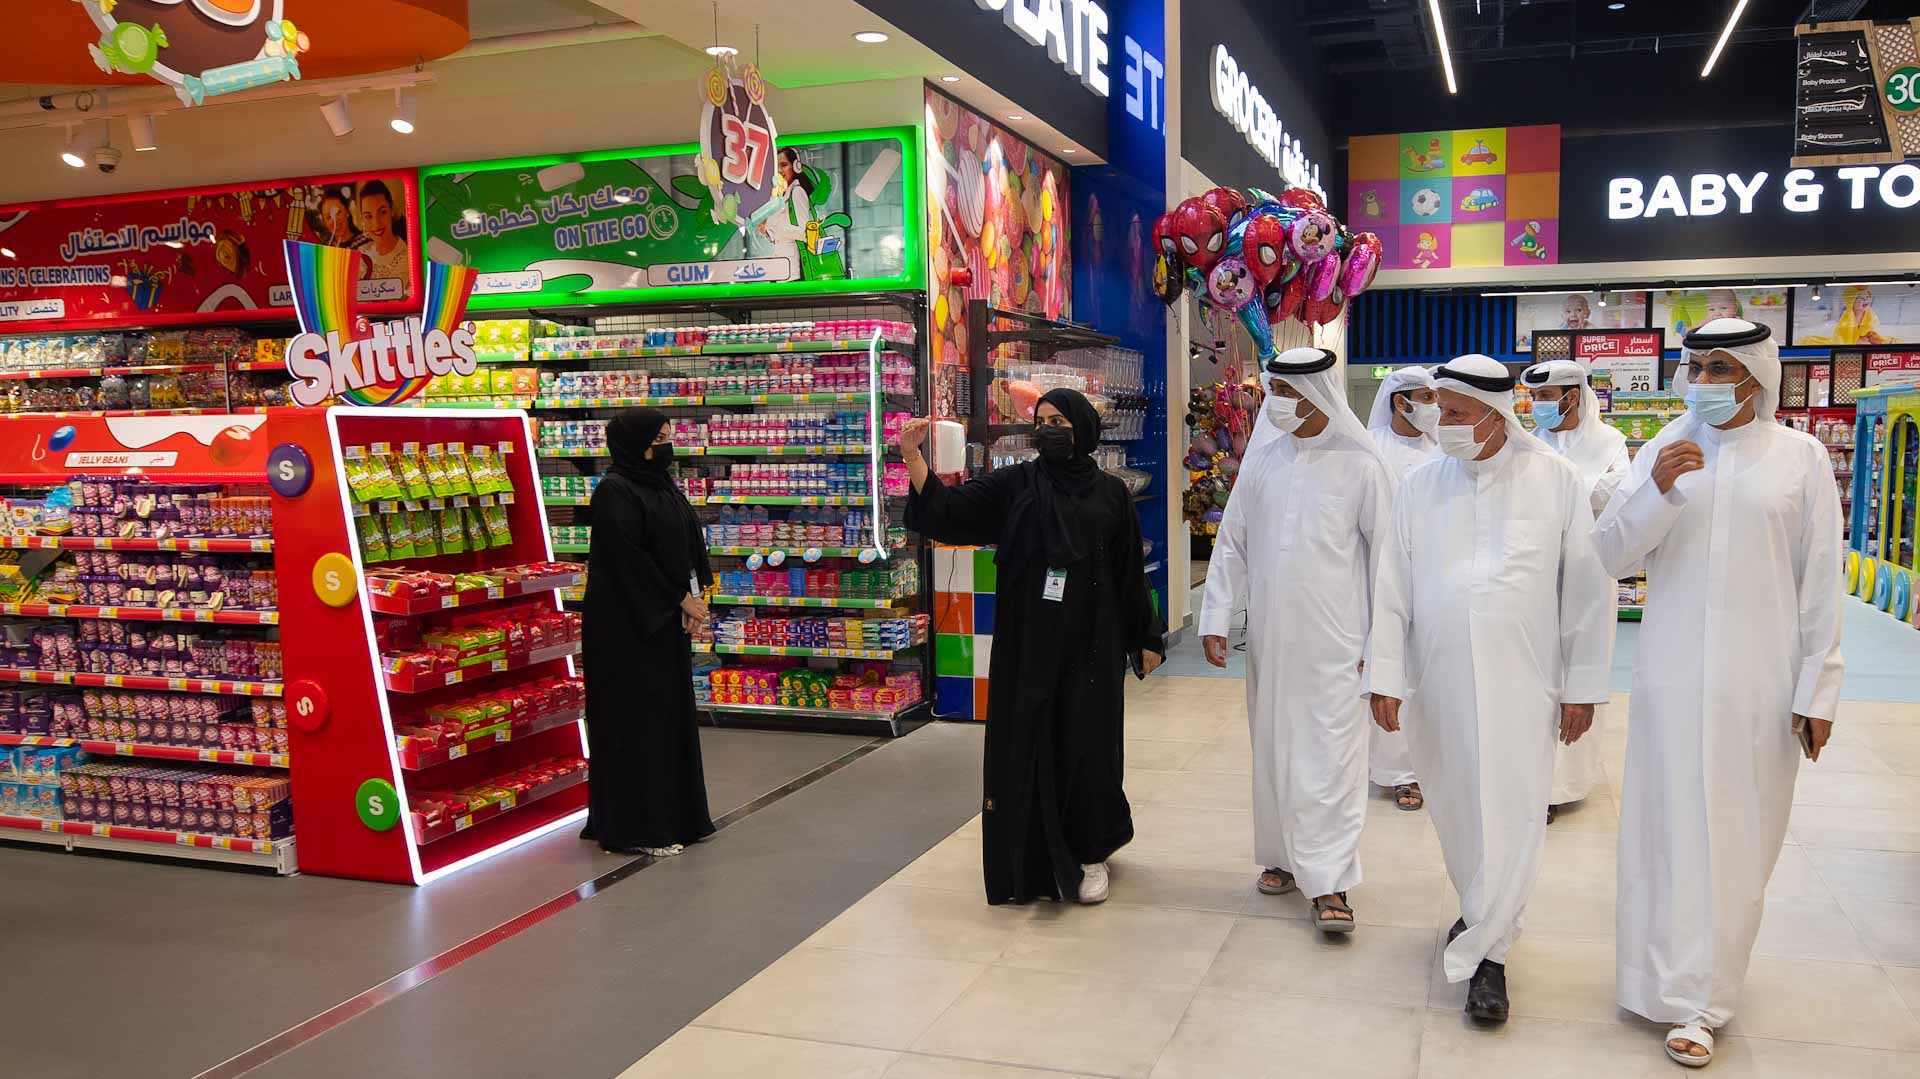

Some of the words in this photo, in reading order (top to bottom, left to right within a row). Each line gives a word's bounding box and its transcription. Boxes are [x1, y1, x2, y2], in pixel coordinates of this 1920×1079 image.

[974, 0, 1109, 97] LATE
[1802, 79, 1819, 87] Baby
[1212, 44, 1282, 168] GROCERY
[1801, 133, 1818, 141] Baby
[722, 114, 770, 190] 37
[1608, 172, 1769, 220] BABY
[1782, 168, 1824, 213] &
[1837, 164, 1920, 210] TO
[542, 193, 588, 224] بكل
[141, 217, 216, 251] مواسم
[555, 223, 583, 250] ON
[582, 217, 620, 248] THE
[621, 214, 651, 239] GO
[60, 225, 138, 262] الاحتفال
[17, 270, 27, 285] &
[29, 265, 111, 286] CELEBRATIONS
[667, 265, 710, 283] GUM
[1584, 342, 1615, 352] PRICE
[288, 317, 478, 405] Skittles
[1873, 359, 1898, 367] PRICE
[1631, 382, 1650, 392] 20
[78, 456, 101, 465] JELLY
[102, 456, 129, 464] BEANS
[279, 460, 294, 482] S
[325, 571, 341, 591] S
[296, 696, 314, 717] S
[369, 795, 385, 816] S
